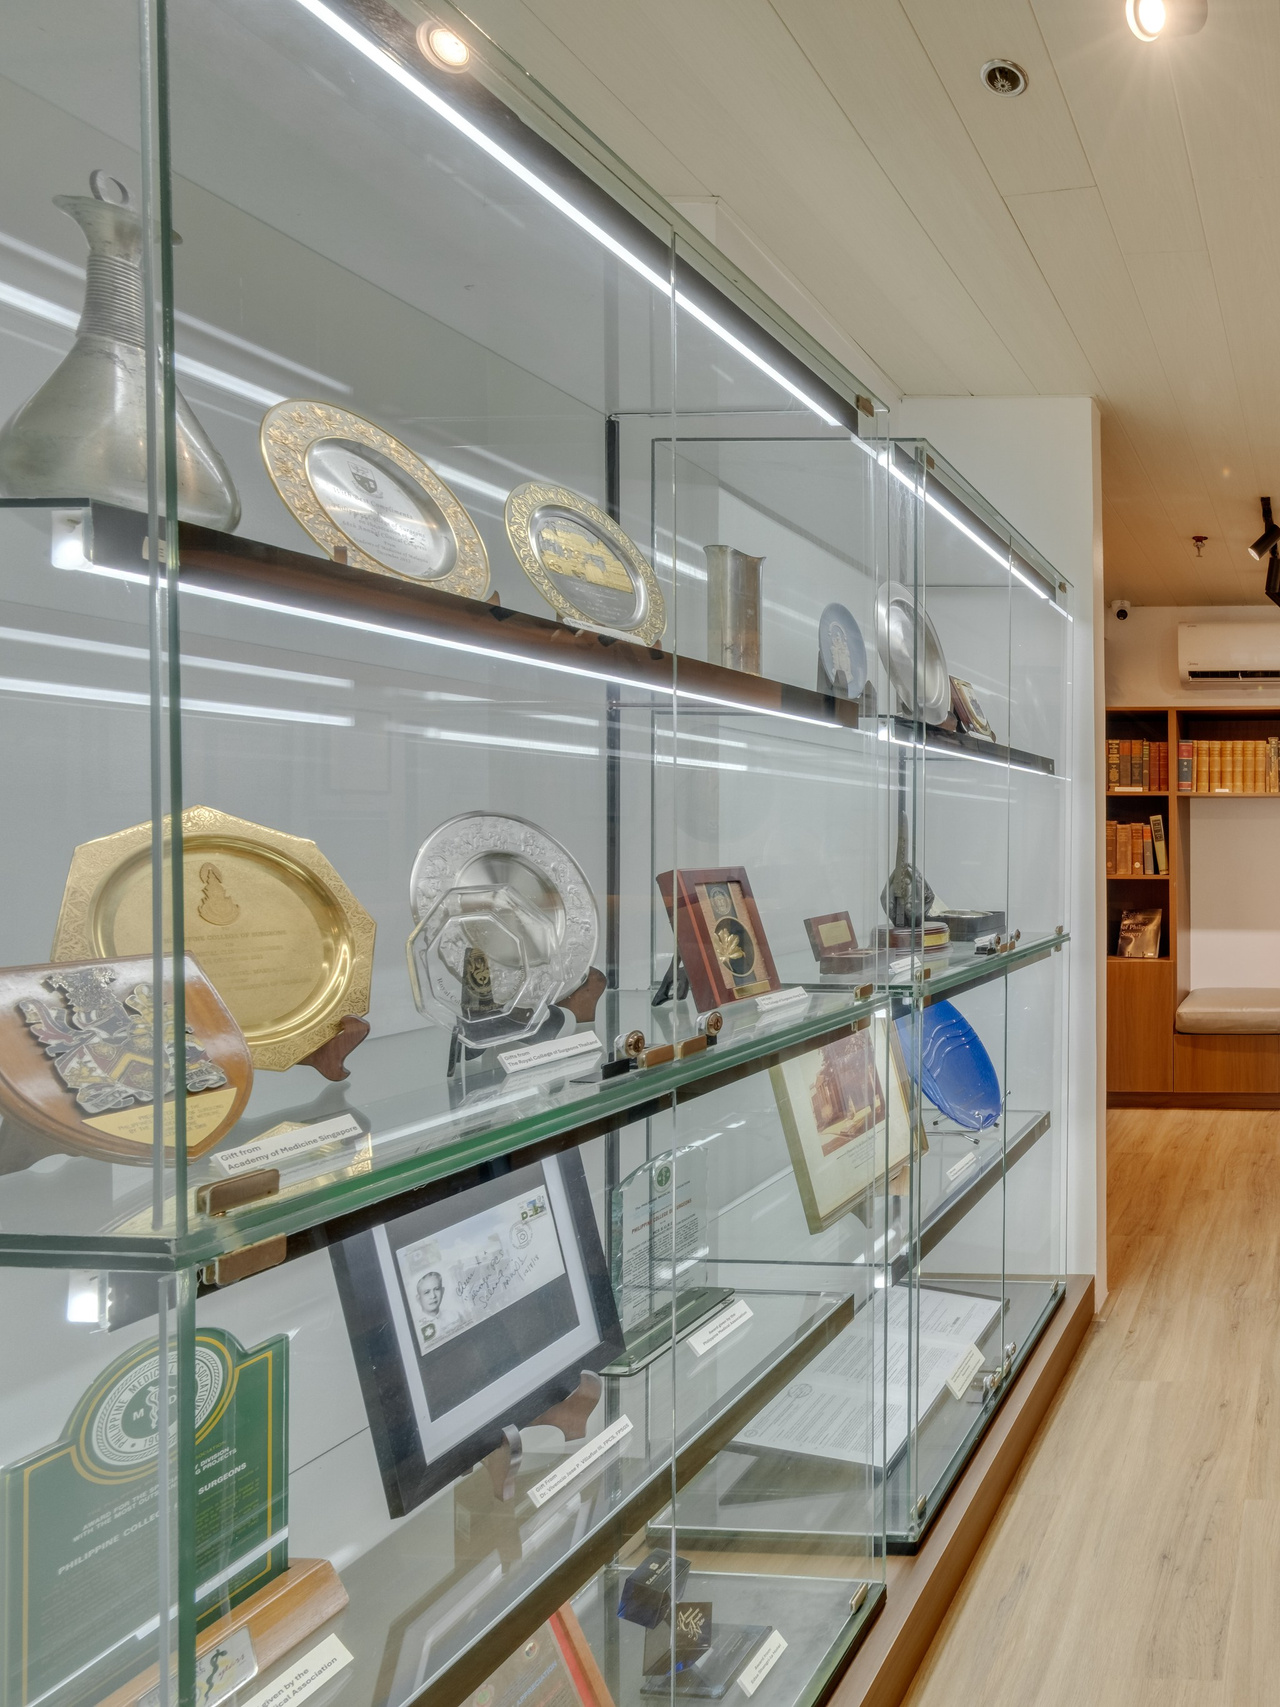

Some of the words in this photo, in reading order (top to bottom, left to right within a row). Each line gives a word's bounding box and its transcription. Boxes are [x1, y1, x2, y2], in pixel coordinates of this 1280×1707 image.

[503, 1054, 519, 1062] Gifts
[518, 1056, 533, 1065] Royal
[533, 1051, 552, 1060] College
[558, 1045, 579, 1055] Surgeons
[578, 1039, 599, 1049] Thailand
[220, 1150, 239, 1162] Gift
[239, 1144, 262, 1157] from
[227, 1153, 270, 1171] Academy
[271, 1149, 280, 1157] of
[281, 1138, 319, 1154] Medicine
[318, 1125, 358, 1141] Singapore
[108, 1399, 129, 1449] PHILIPPINE
[132, 1408, 145, 1420] M
[82, 1510, 112, 1532] AWARD
[113, 1500, 131, 1515] FOR
[132, 1491, 148, 1505] THE
[200, 1446, 230, 1467] DIVISION
[535, 1483, 546, 1493] Gift
[544, 1473, 558, 1486] From
[539, 1491, 549, 1499] Dr.
[546, 1475, 567, 1492] Vivencio
[566, 1467, 578, 1480] Jose
[580, 1450, 599, 1465] Villaflor
[72, 1527, 94, 1543] WITH
[96, 1519, 112, 1532] THE
[114, 1504, 136, 1520] MOST
[202, 1447, 237, 1472] PROJECTS
[57, 1534, 120, 1576] PHILIPPINE
[197, 1462, 247, 1495] SURGEONS
[260, 1687, 285, 1707] given
[283, 1678, 296, 1691] by
[294, 1668, 310, 1681] the
[291, 1656, 338, 1695] Association
